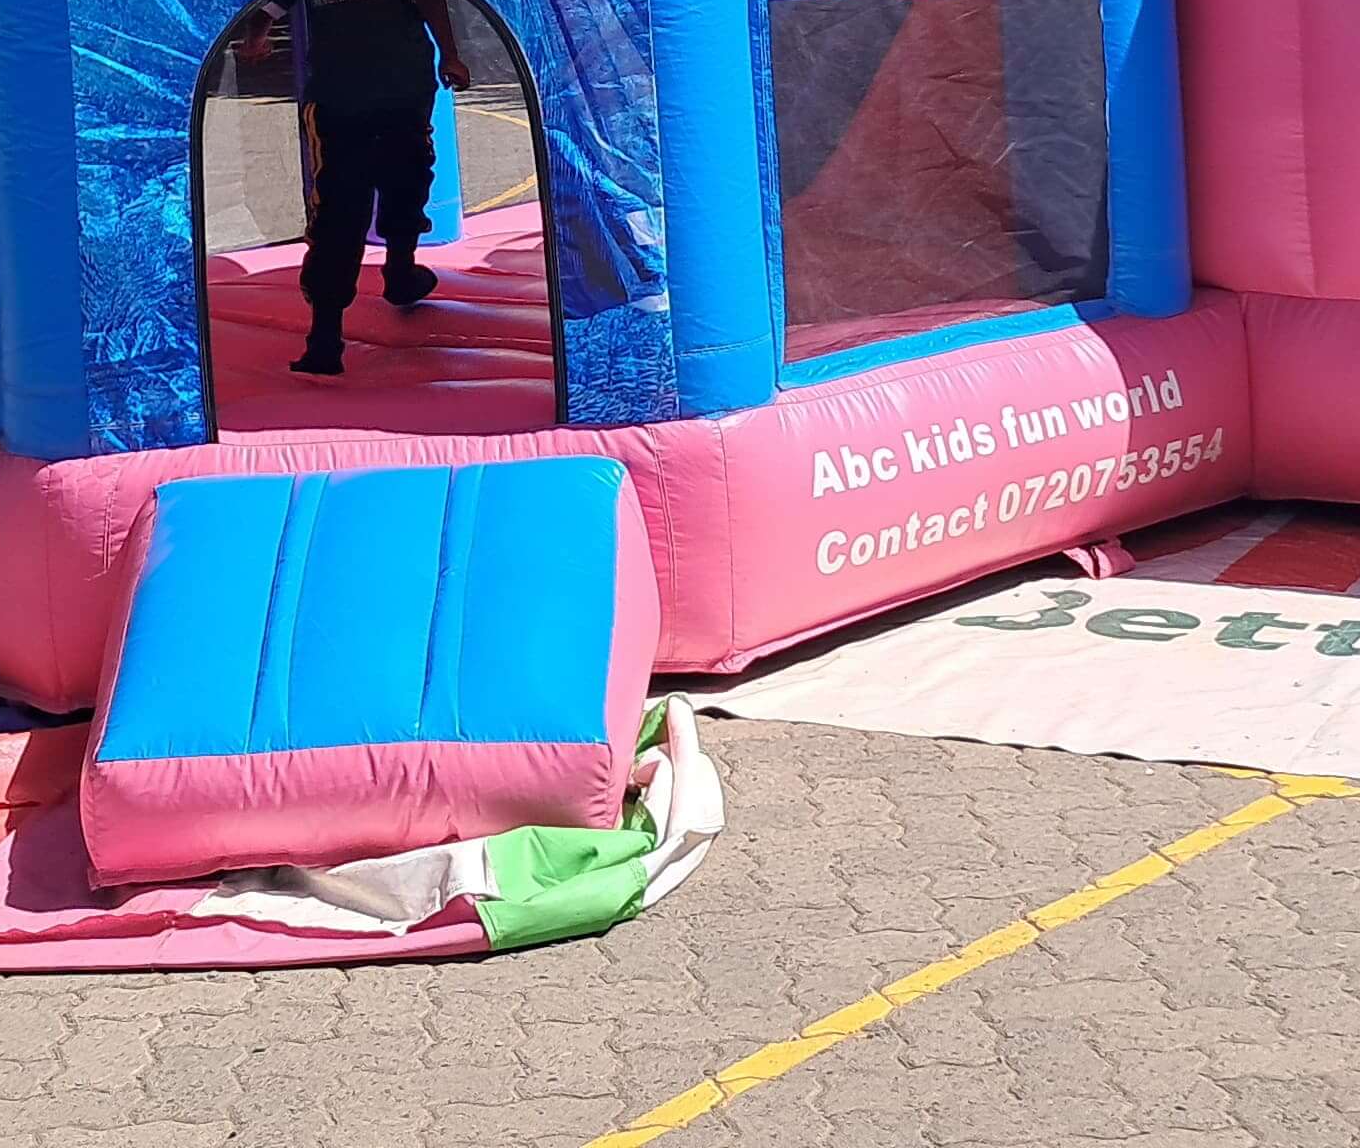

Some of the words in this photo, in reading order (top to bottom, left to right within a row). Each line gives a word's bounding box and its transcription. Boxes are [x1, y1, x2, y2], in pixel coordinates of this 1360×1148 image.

[812, 446, 898, 498] Abc
[903, 418, 997, 474] kids
[1000, 403, 1068, 449] fun
[1072, 369, 1184, 430] world
[815, 491, 989, 575] Contact
[998, 427, 1225, 524] 0720753554
